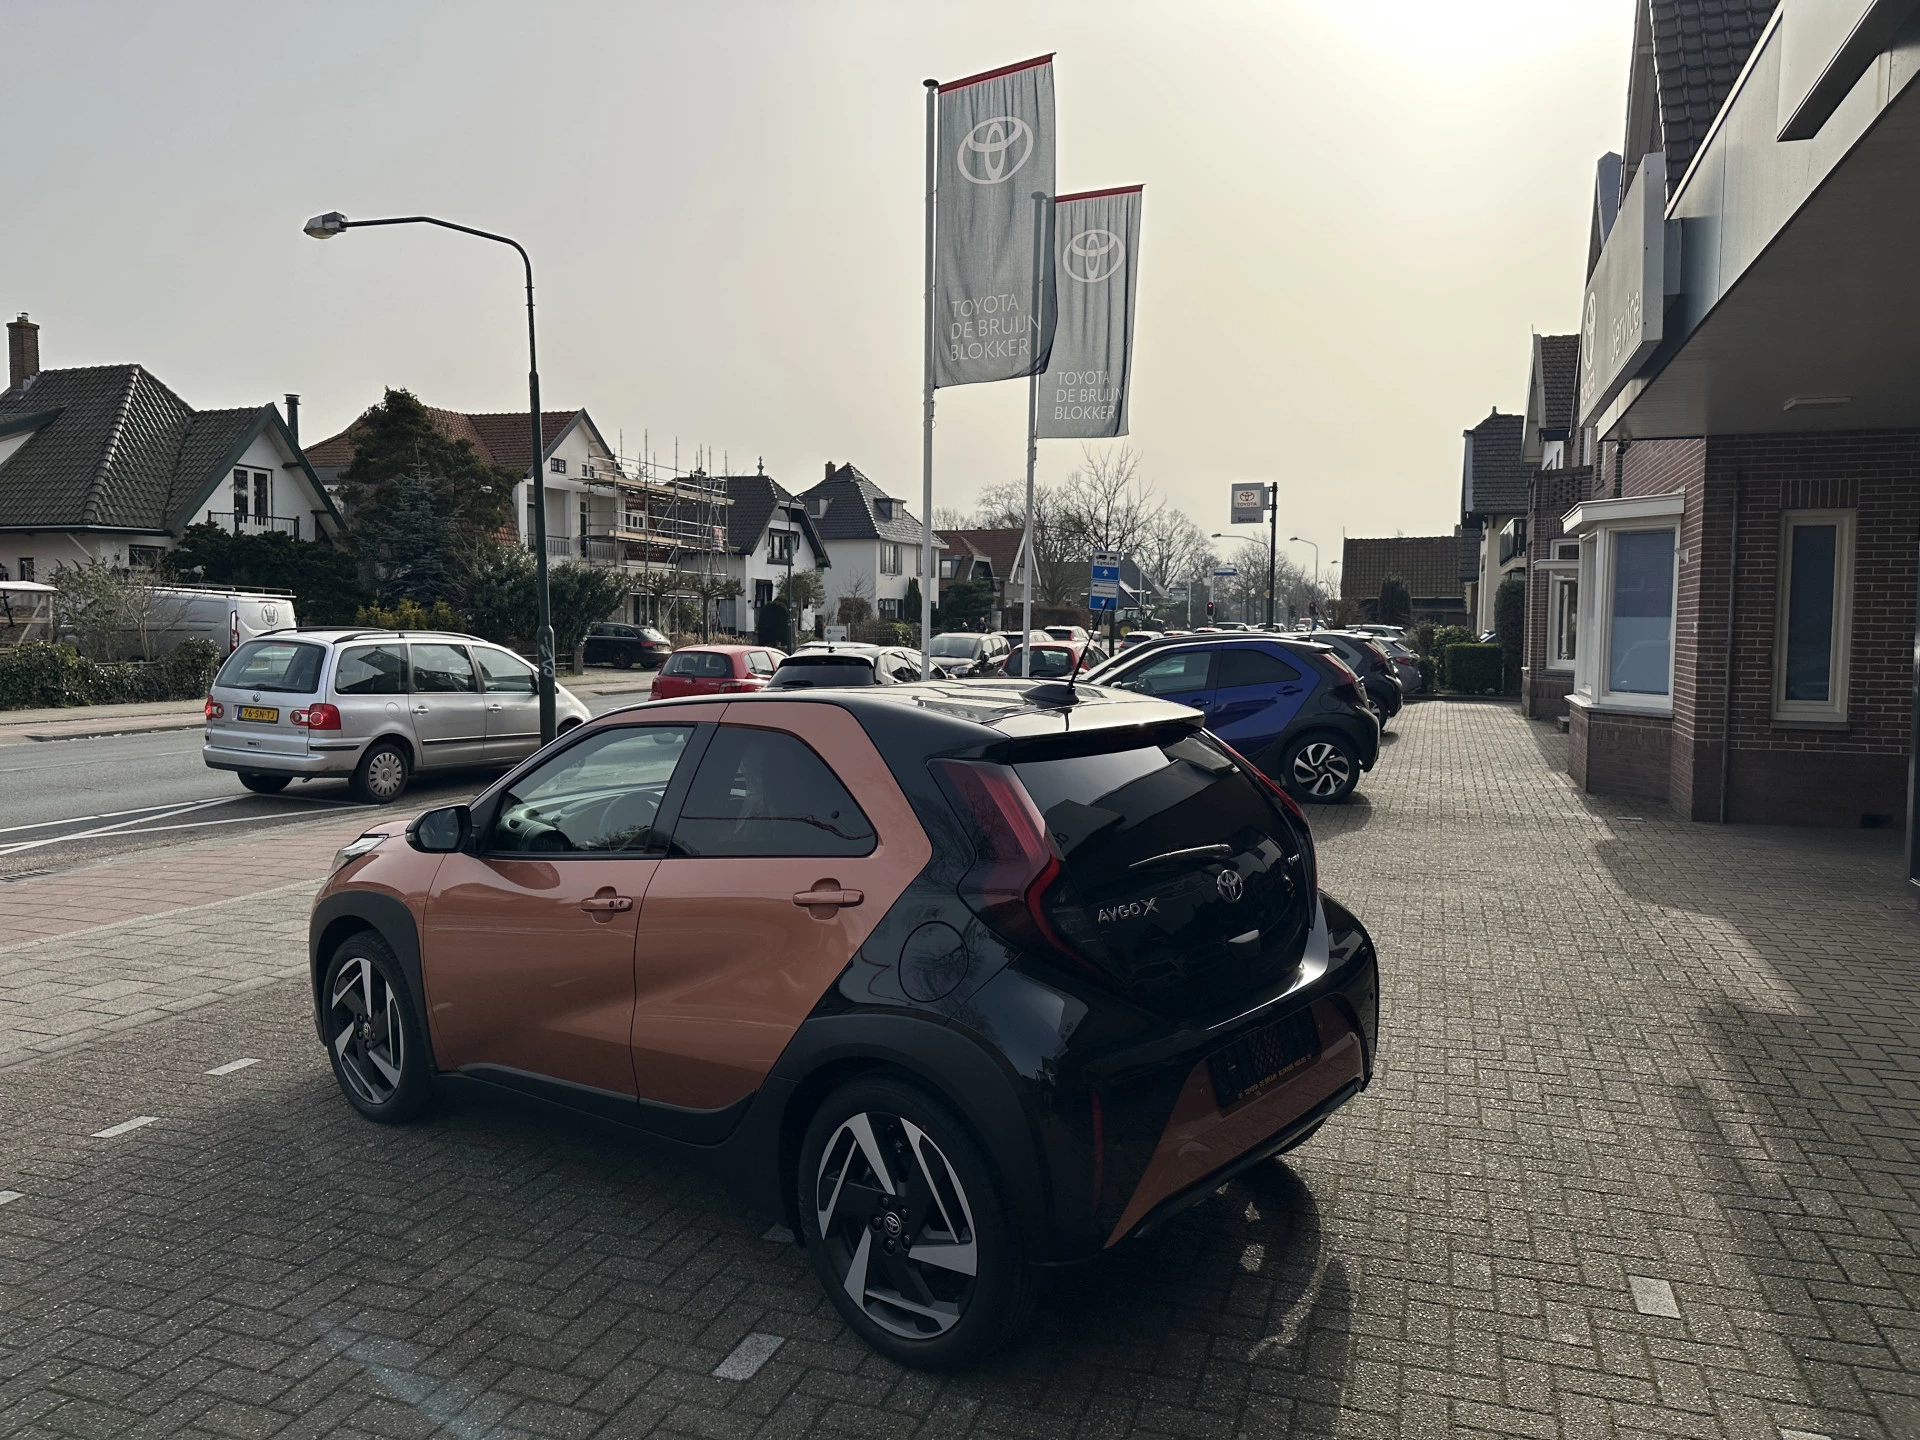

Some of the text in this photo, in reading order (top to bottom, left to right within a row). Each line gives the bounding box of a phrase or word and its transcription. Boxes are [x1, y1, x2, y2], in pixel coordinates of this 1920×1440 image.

[952, 294, 1018, 317] TOYOTA
[951, 314, 1041, 339] DE BRUIJN
[1611, 290, 1640, 365] Service
[951, 338, 1029, 361] BLOKKER
[1056, 370, 1110, 386] TOYOTA
[1056, 388, 1076, 403] DE
[1054, 405, 1116, 420] BLOKKER
[244, 709, 275, 719] 76-SN-TJ
